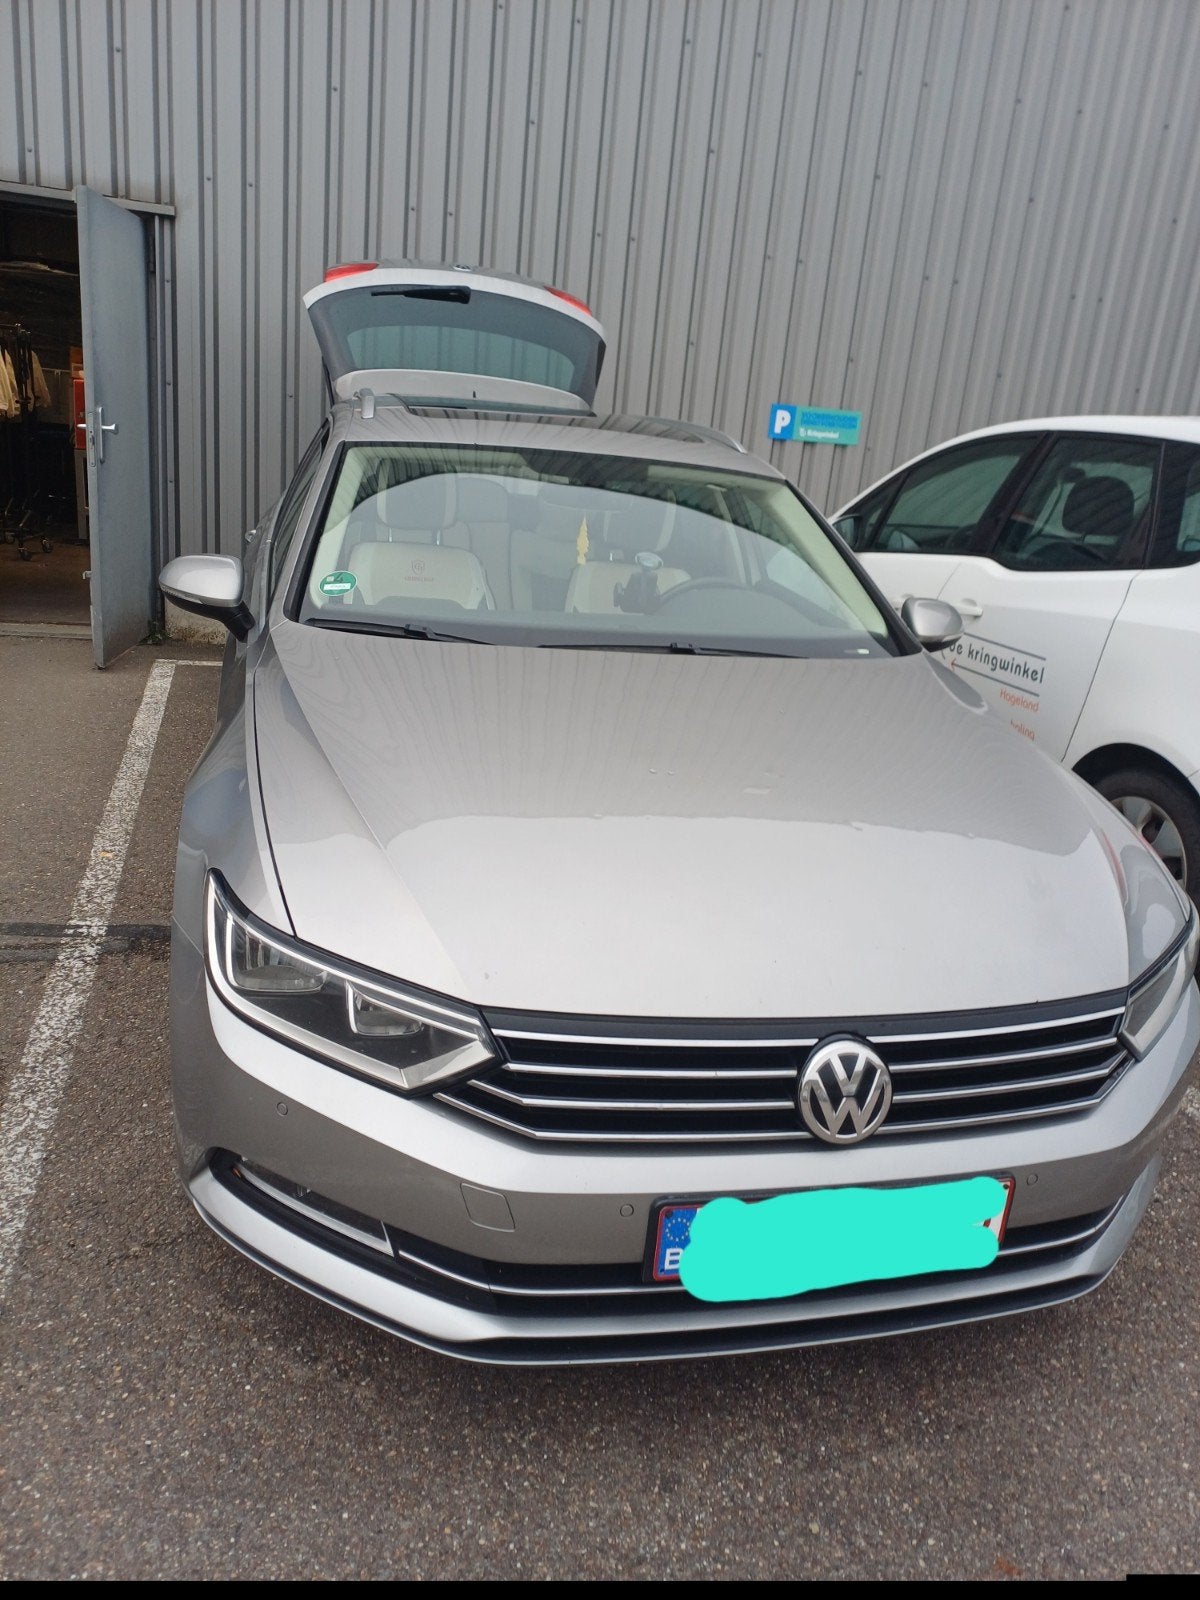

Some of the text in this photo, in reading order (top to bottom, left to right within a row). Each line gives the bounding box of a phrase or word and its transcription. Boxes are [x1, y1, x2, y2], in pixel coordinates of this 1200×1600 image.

[774, 409, 791, 434] P
[967, 643, 1045, 684] kringwinkel
[804, 1045, 889, 1141] VW
[664, 1248, 682, 1270] B
